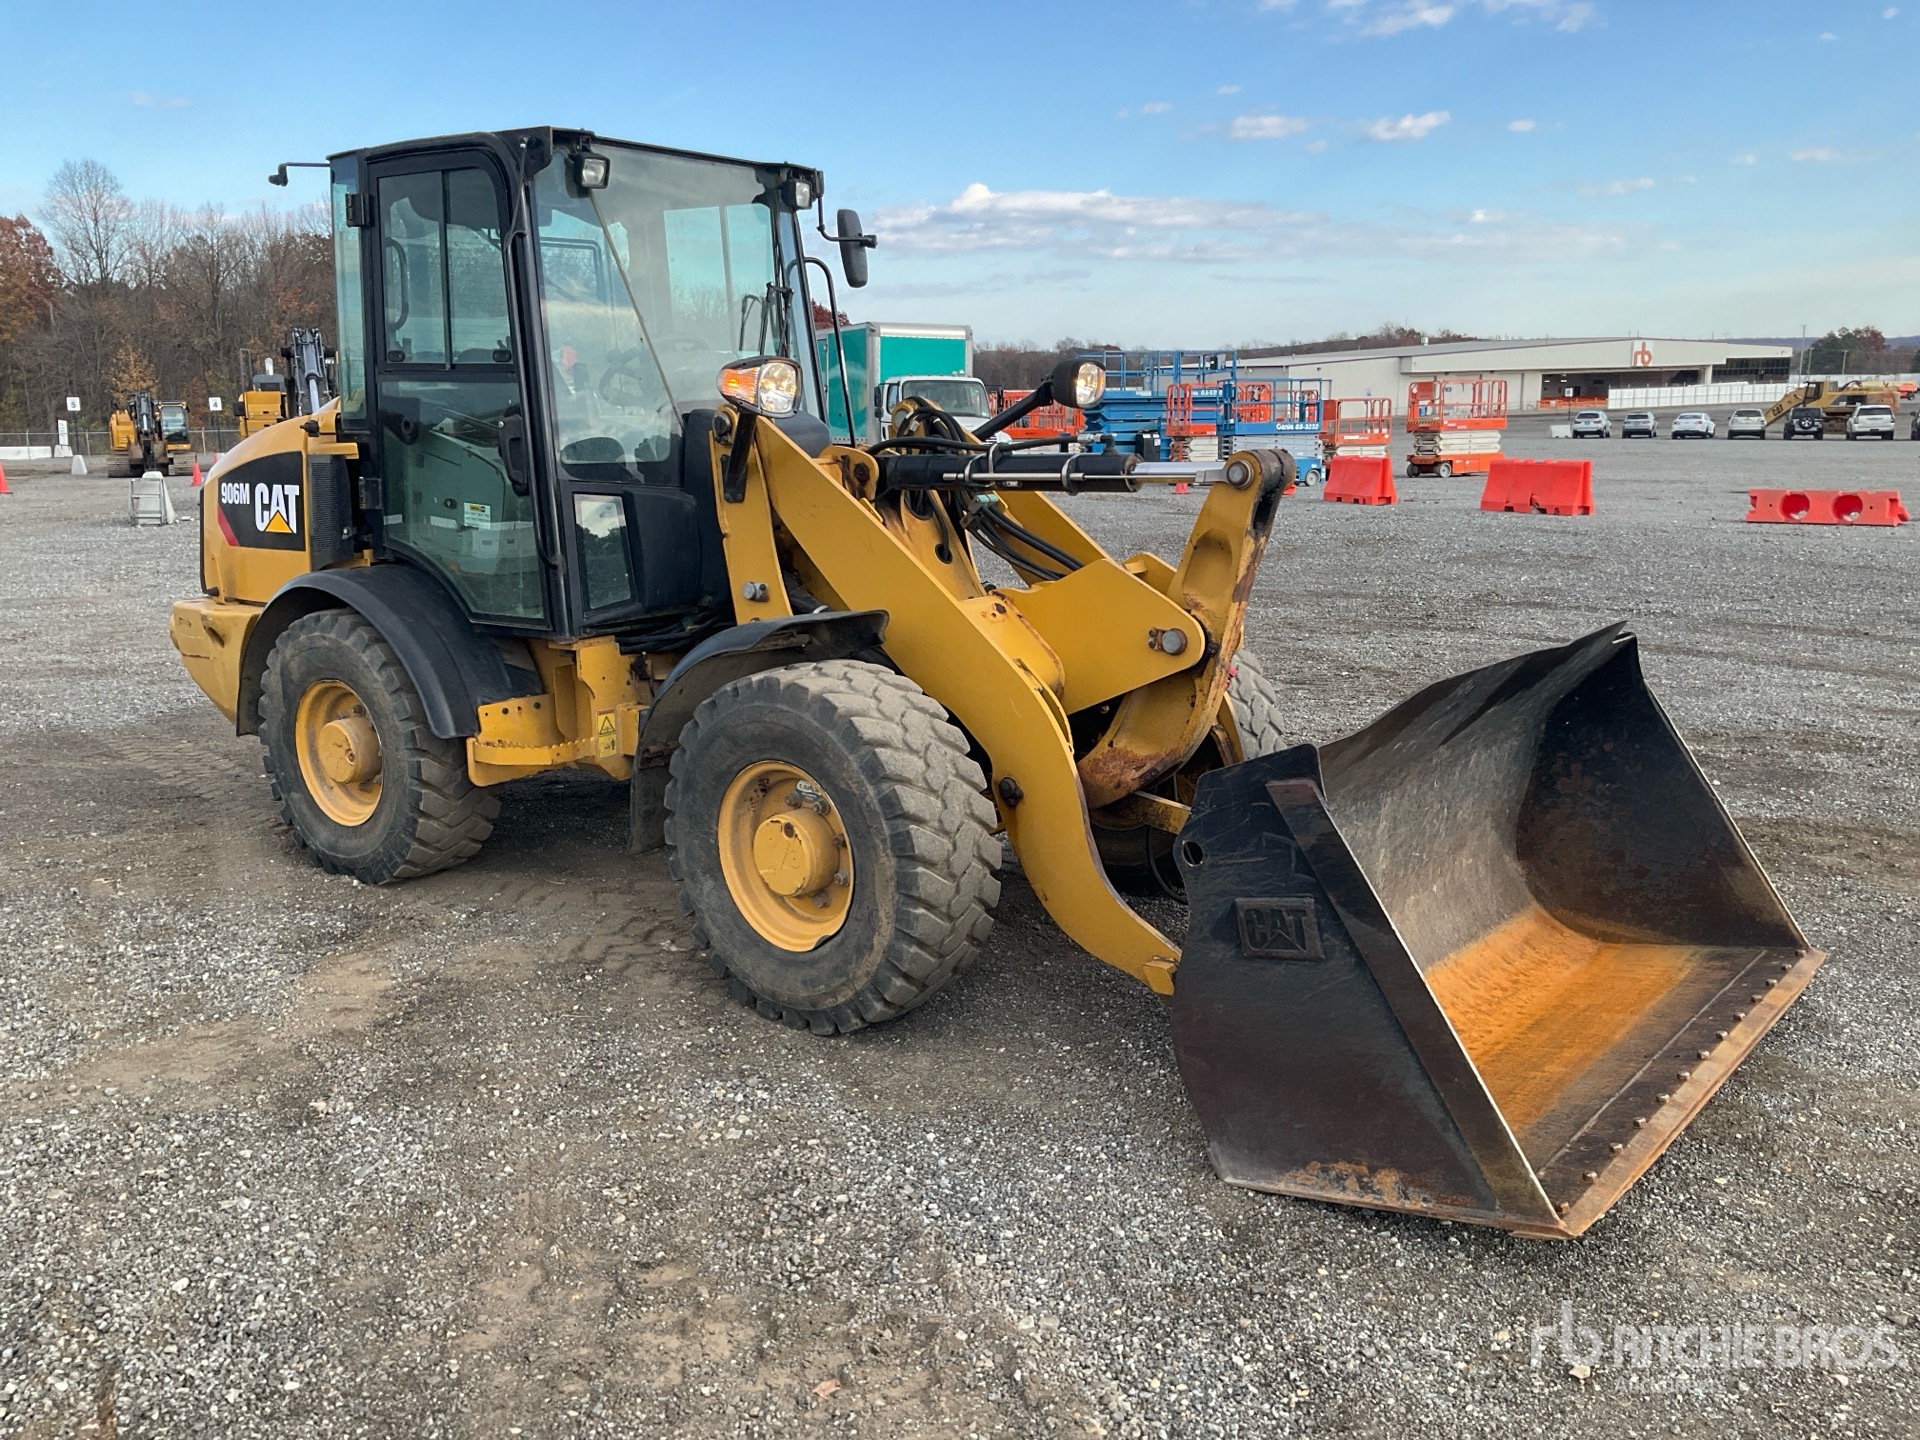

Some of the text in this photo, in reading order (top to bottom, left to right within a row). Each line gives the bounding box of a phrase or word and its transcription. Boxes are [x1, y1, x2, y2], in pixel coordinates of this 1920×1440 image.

[1633, 341, 1653, 367] rb
[1771, 403, 1784, 417] CAT
[221, 482, 300, 534] 906M CAT
[1244, 908, 1308, 952] CAT
